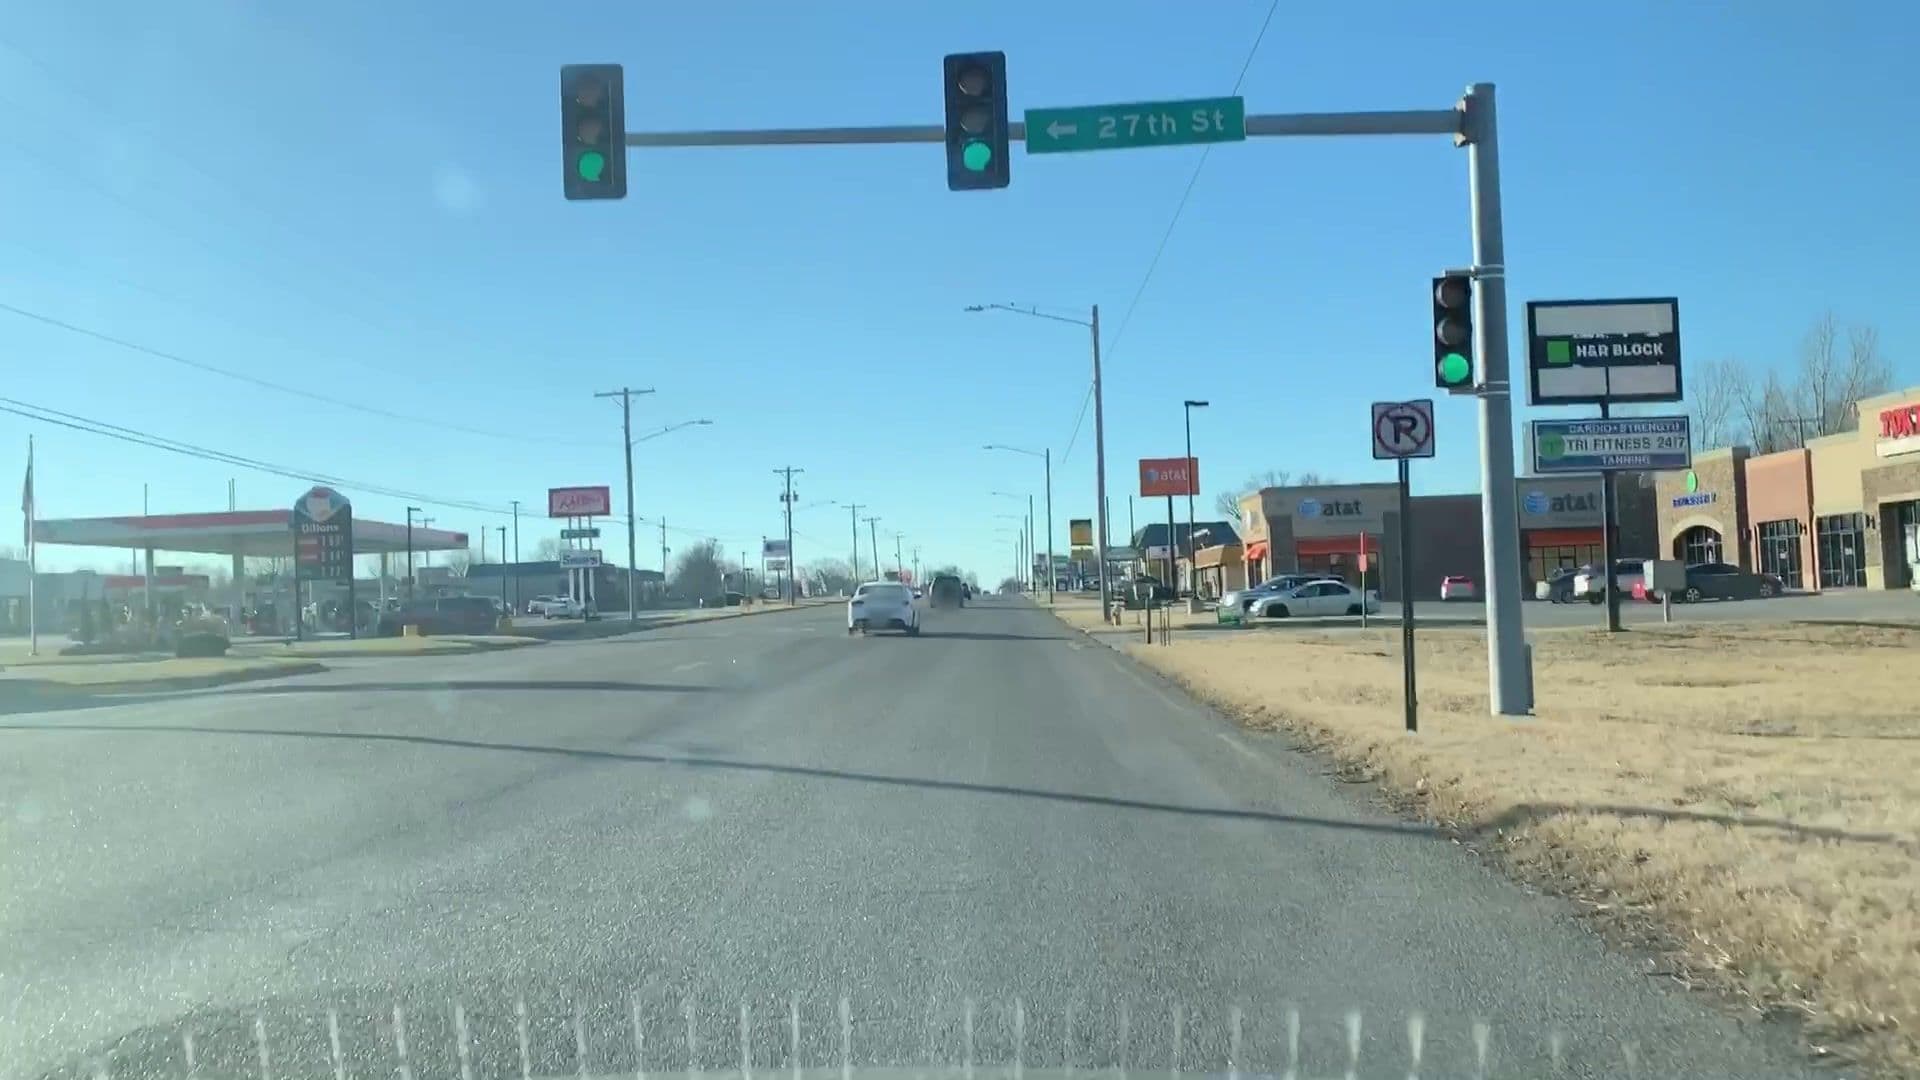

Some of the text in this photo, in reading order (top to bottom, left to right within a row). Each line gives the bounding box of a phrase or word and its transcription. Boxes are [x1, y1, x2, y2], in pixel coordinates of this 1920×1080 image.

[1098, 108, 1224, 139] 27th St
[1576, 343, 1664, 358] H&R BLOCK
[1567, 438, 1589, 451] TRI
[1593, 437, 1651, 451] FITNESS
[1601, 455, 1651, 465] TANNING
[1160, 468, 1187, 481] at&t
[1322, 499, 1362, 516] at&t
[1551, 492, 1596, 512] at&t
